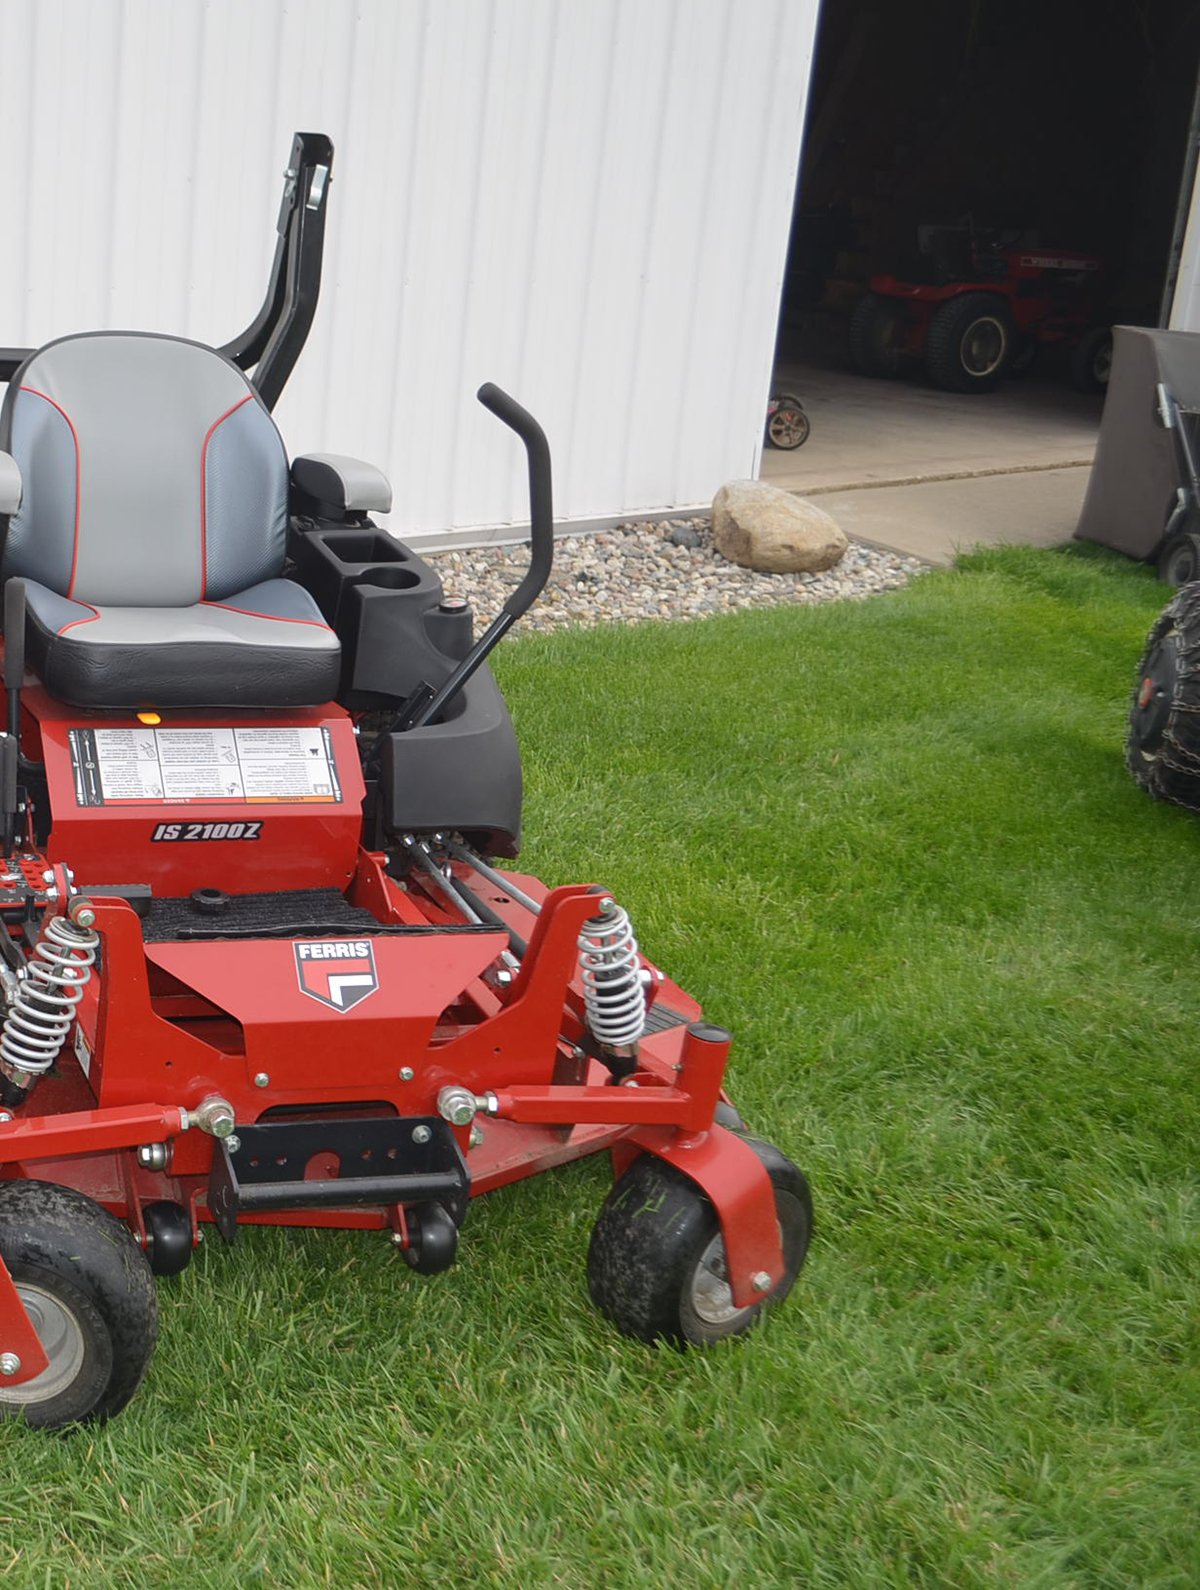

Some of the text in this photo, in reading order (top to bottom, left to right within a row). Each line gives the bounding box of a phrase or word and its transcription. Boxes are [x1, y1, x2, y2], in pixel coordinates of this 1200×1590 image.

[153, 822, 262, 840] IS 2100Z
[298, 942, 369, 959] FERRIS
